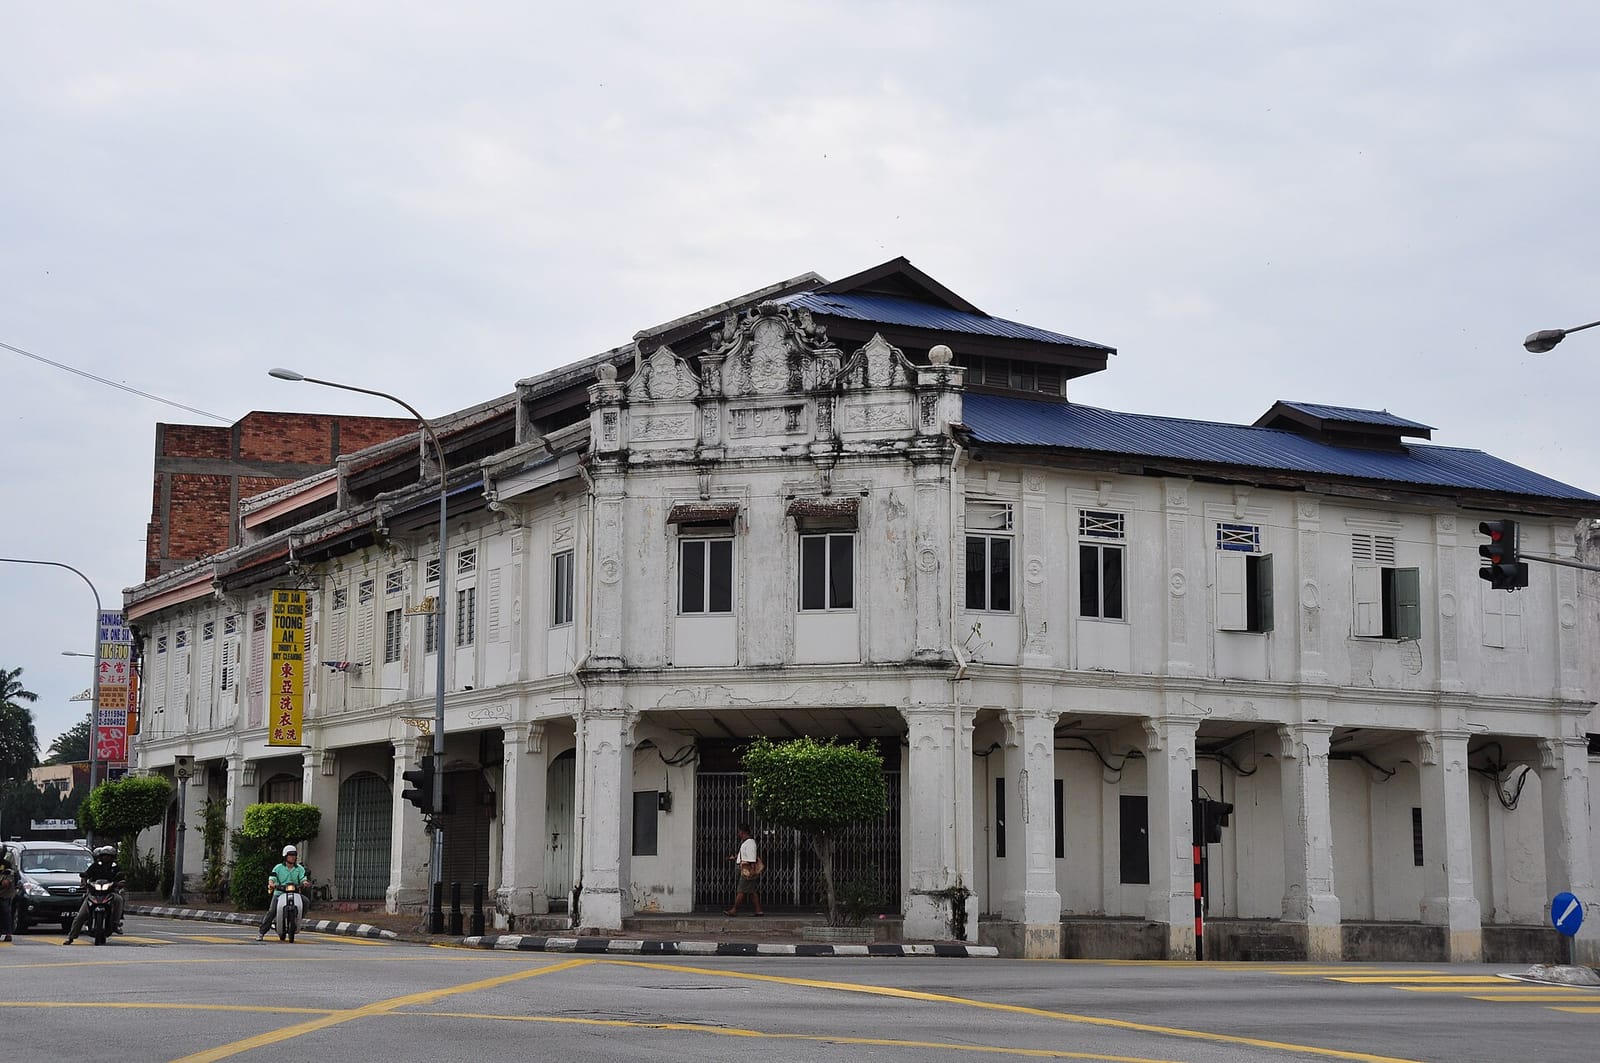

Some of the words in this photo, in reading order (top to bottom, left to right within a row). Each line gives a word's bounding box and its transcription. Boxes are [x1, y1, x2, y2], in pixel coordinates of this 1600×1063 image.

[274, 616, 303, 629] TOONG
[111, 628, 120, 640] ONE
[282, 630, 294, 642] AH
[100, 643, 113, 659] ING
[279, 662, 294, 727] 東亞洗衣
[274, 728, 297, 740] 乾洗
